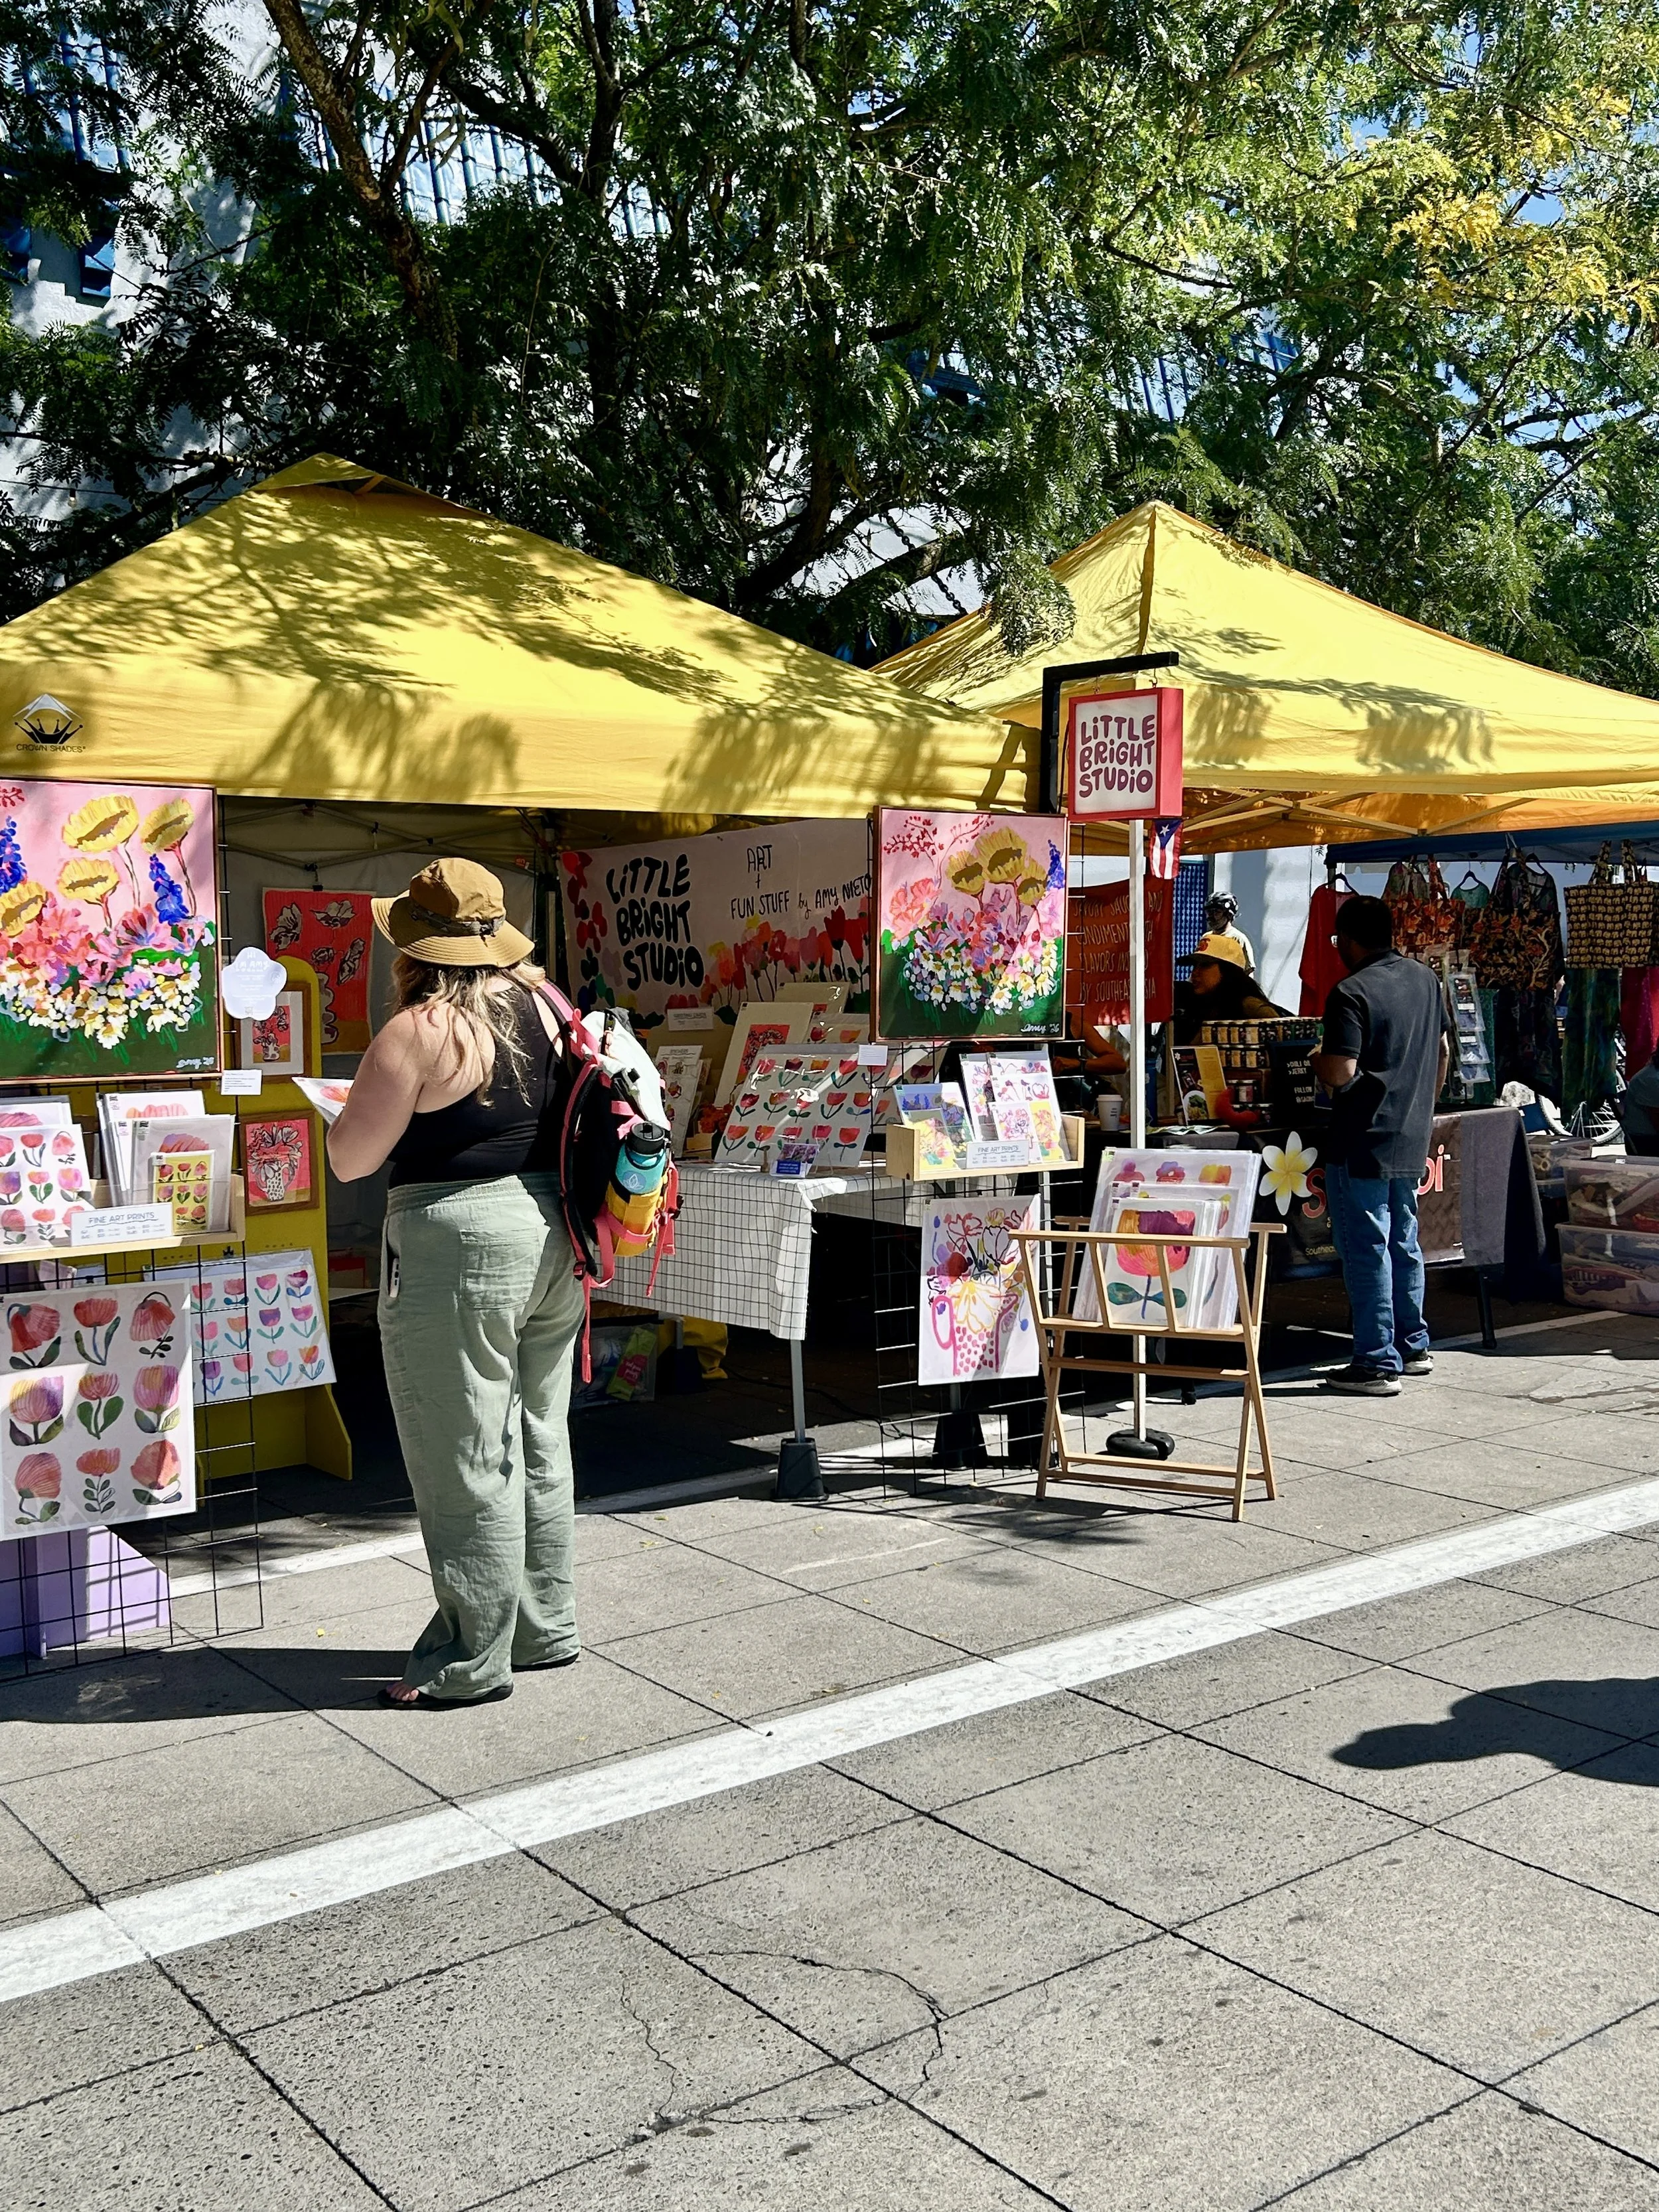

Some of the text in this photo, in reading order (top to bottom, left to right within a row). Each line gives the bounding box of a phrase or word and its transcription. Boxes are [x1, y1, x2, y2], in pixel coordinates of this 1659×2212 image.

[747, 845, 772, 873] ART
[731, 896, 755, 919] FUN
[758, 890, 790, 915] STUFF
[798, 893, 812, 920] by
[841, 872, 872, 903] NIETO
[1075, 921, 1129, 946] CONDIMENT
[89, 1216, 108, 1224] FINE
